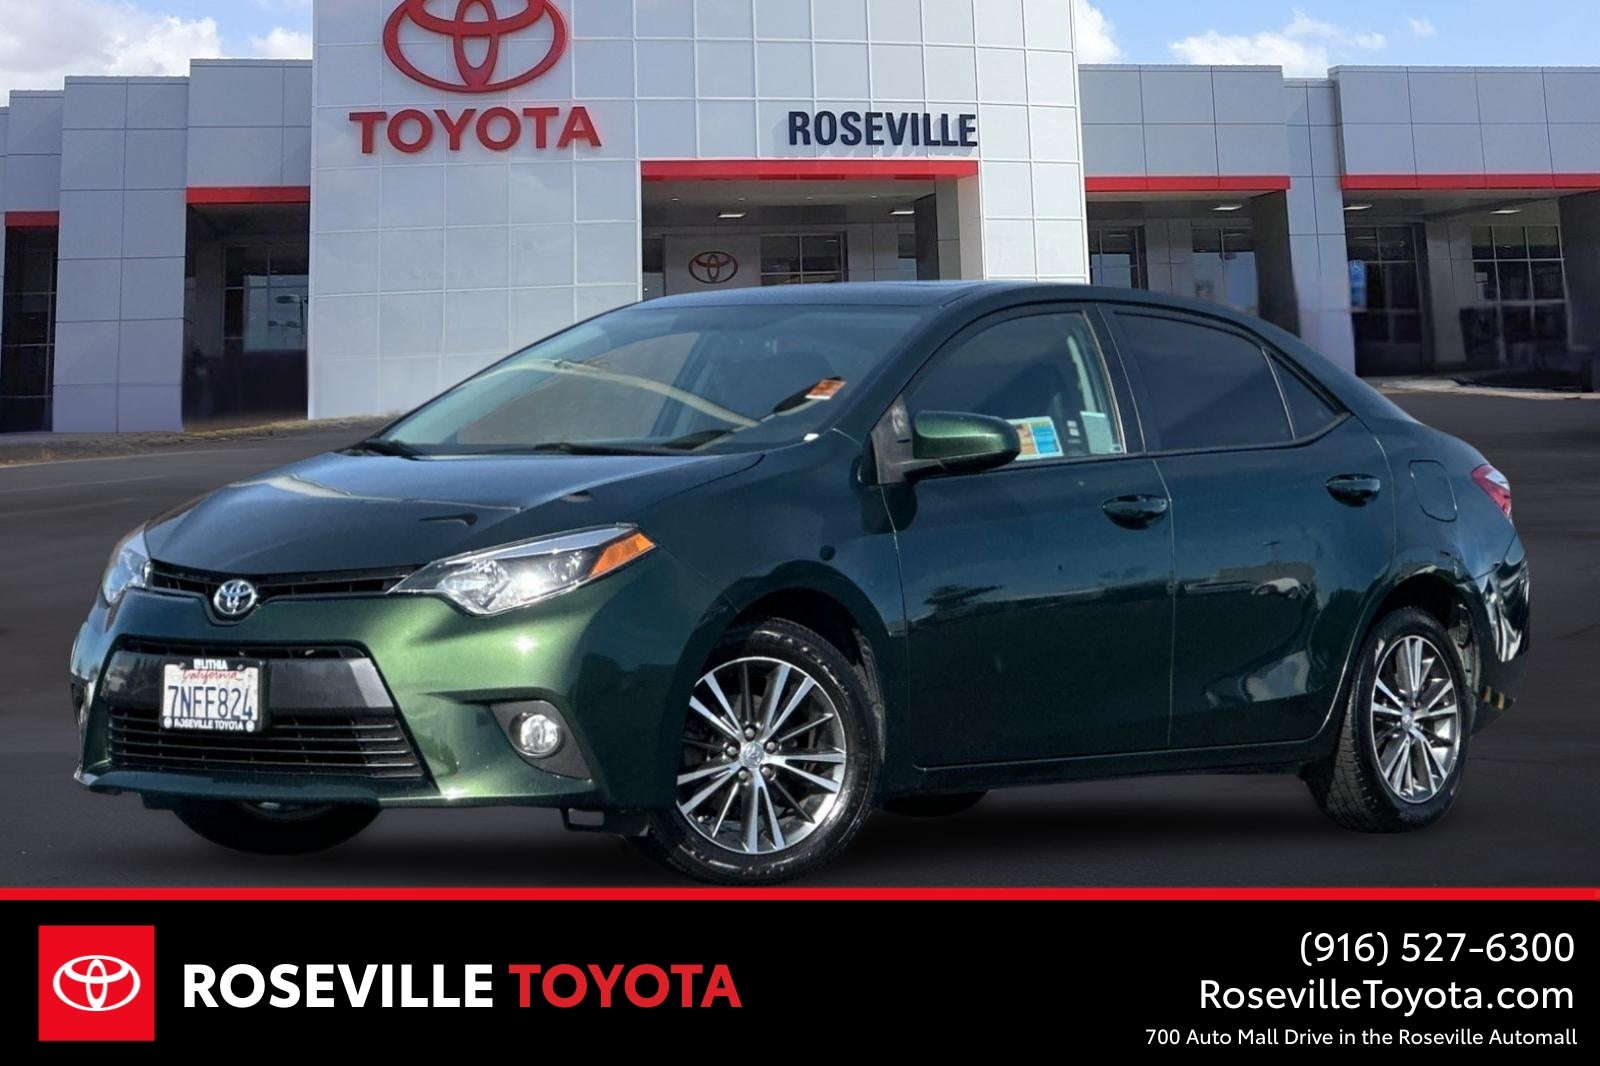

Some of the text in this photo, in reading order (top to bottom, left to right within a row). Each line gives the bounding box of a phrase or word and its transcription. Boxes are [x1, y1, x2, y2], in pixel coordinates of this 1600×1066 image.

[349, 106, 602, 154] TOYOTA
[789, 111, 978, 148] ROSEVILLE
[168, 686, 253, 719] 7NFF824
[215, 720, 243, 730] TOYOTA
